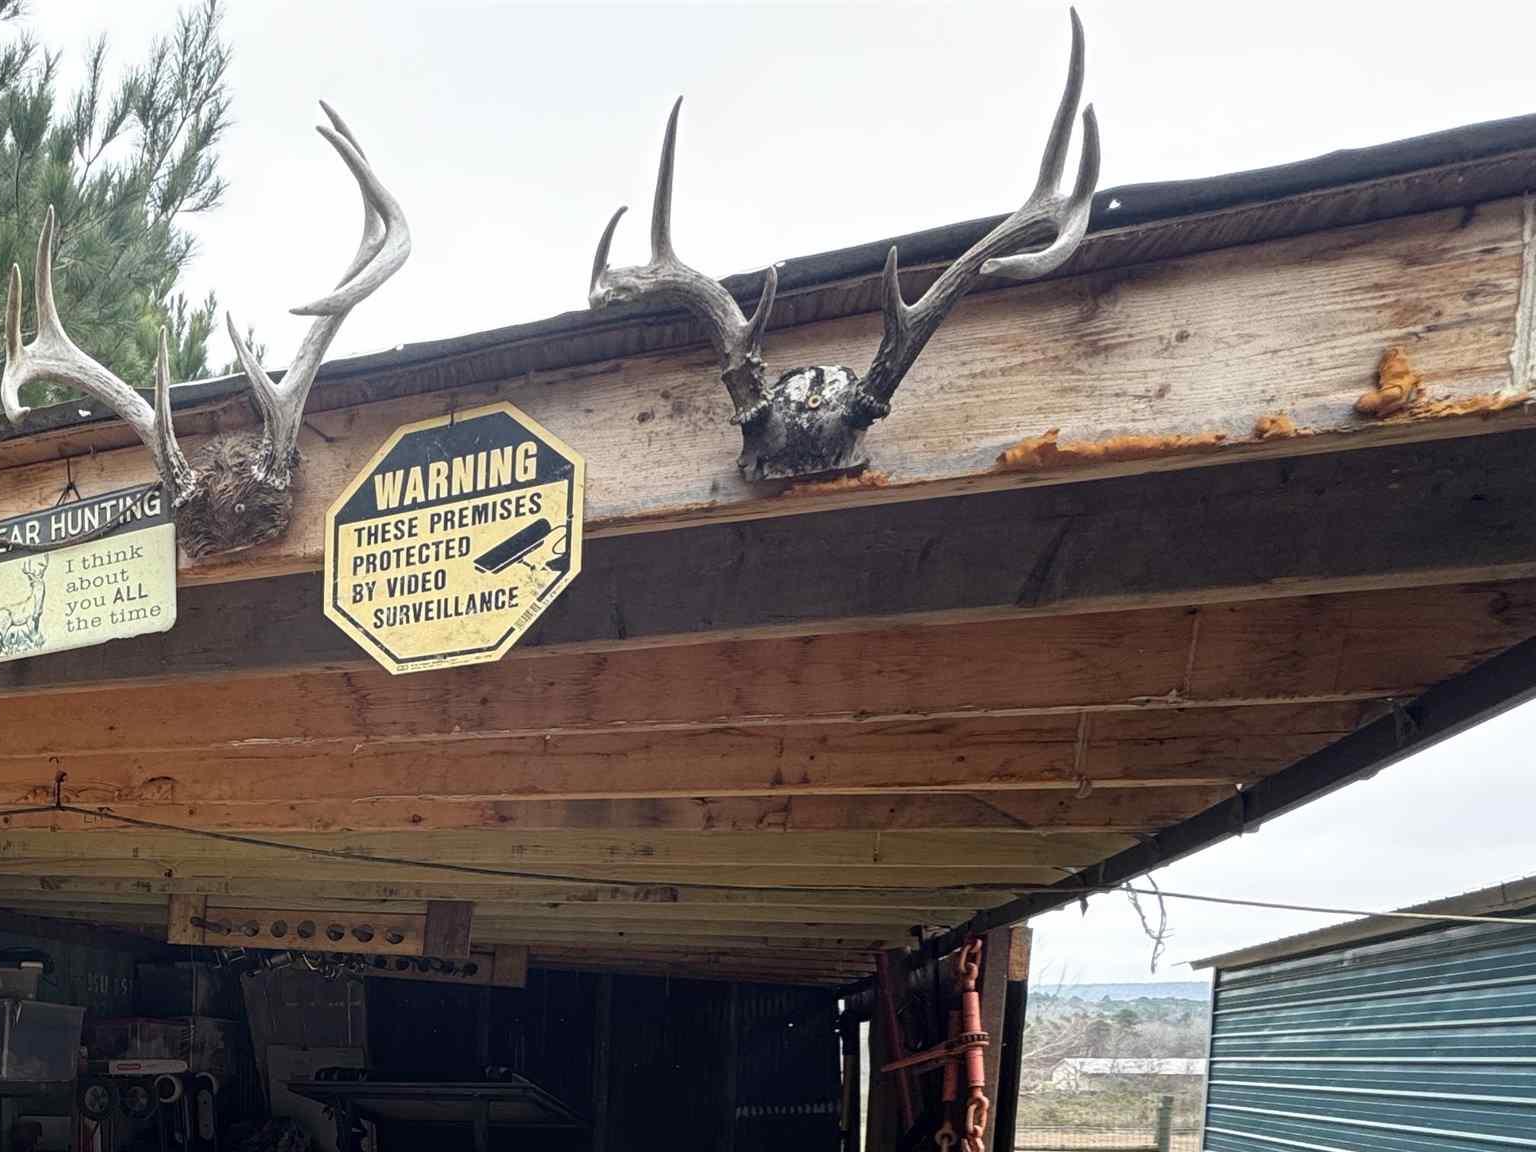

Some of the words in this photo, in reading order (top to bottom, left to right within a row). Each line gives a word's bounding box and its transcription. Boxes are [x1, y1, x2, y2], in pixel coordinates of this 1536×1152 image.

[375, 442, 538, 511] WARNING
[51, 491, 160, 540] HUNTING
[354, 517, 418, 548] THESE
[430, 493, 542, 534] PREMISES
[65, 560, 73, 574] I
[82, 545, 144, 570] think
[353, 536, 470, 577] PROTECTED
[65, 569, 129, 593] about
[65, 595, 106, 616] you
[112, 582, 148, 604] ALL
[352, 581, 376, 604] BY
[386, 569, 446, 598] VIDEO
[66, 616, 103, 633] the
[110, 605, 161, 625] time
[373, 587, 519, 629] SURVEILLANCE
